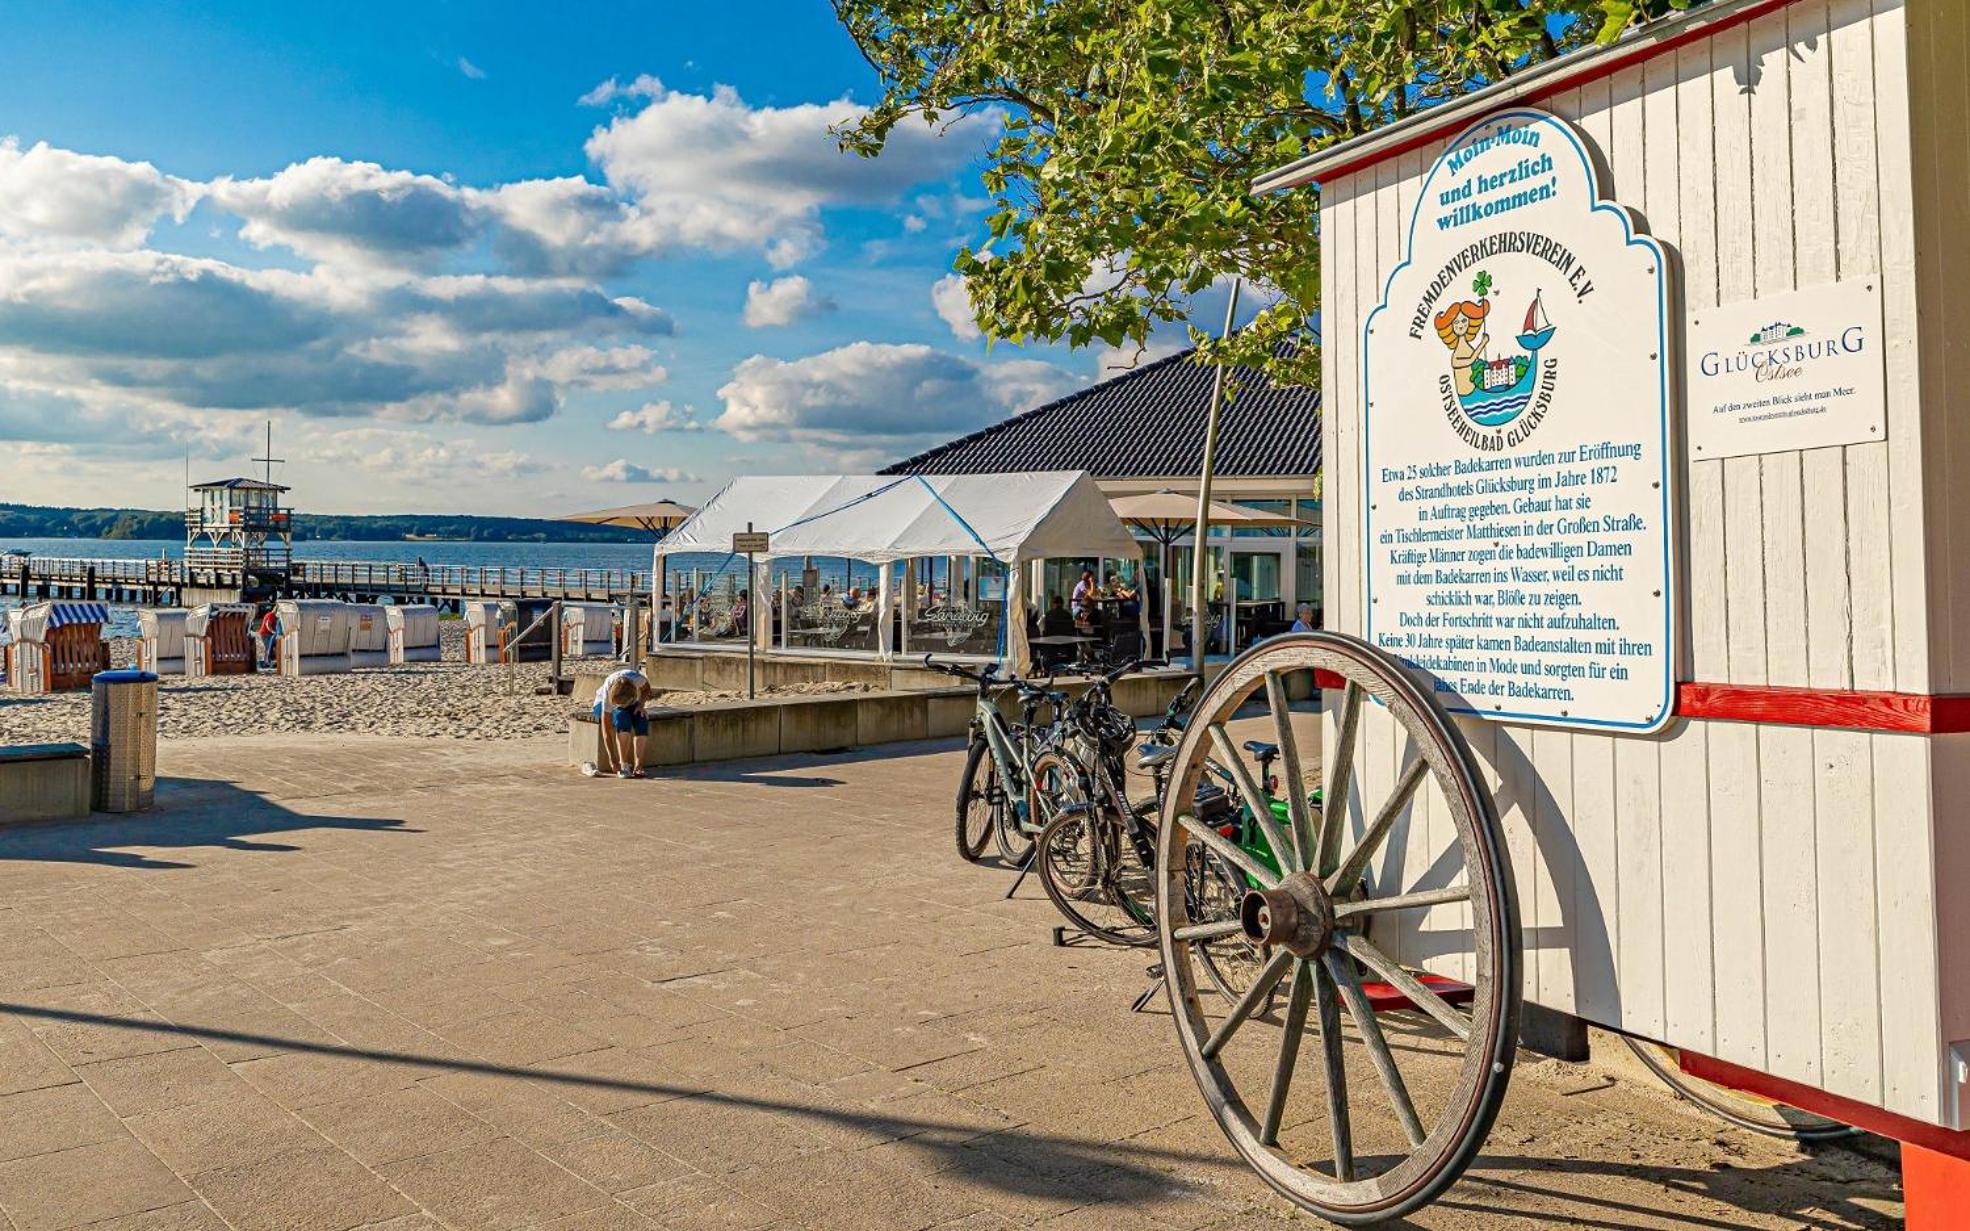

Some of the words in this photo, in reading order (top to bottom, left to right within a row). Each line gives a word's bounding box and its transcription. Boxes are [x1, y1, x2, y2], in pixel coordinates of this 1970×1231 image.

[1446, 124, 1541, 176] Moin-Moin
[1439, 178, 1472, 206] und
[1477, 153, 1553, 194] herzlich
[1436, 176, 1557, 230] willkommen!
[1409, 231, 1576, 340] FREMDENVERKEHRSVEREIN
[1568, 265, 1594, 304] E.V.
[1755, 360, 1803, 383] Ostsee
[1438, 373, 1504, 452] OSTSEEHEILBAD
[1507, 357, 1558, 448] GLÜCKSBURG
[1712, 404, 1727, 415] Auf
[1728, 400, 1741, 412] den
[1742, 397, 1771, 409] zweiten
[1772, 394, 1793, 405] Blick
[1794, 391, 1813, 403] sieht
[1814, 389, 1832, 400] man
[1382, 467, 1405, 483] Etwa
[1406, 464, 1418, 480] 25
[1419, 461, 1452, 479] solcher
[1454, 457, 1511, 475] Badekarren
[1514, 450, 1555, 468] wurden
[1558, 450, 1577, 463] zur
[1579, 441, 1641, 461] Eröffnung
[1398, 487, 1414, 502] des
[1415, 480, 1474, 500] Strandhotels
[1475, 475, 1535, 494] Glücksburg
[1538, 473, 1552, 489] im
[1555, 470, 1587, 488] Jahre
[1590, 465, 1618, 485] 1872
[1418, 506, 1428, 521] in
[1431, 503, 1467, 522] Auftrag
[1468, 500, 1511, 521] gegeben.
[1513, 496, 1552, 514] Gebaut
[1555, 495, 1573, 511] hat
[1575, 493, 1591, 509] sie
[1379, 530, 1393, 544] ein
[1395, 526, 1464, 544] Tischlermeister
[1466, 522, 1521, 540] Matthiesen
[1523, 520, 1534, 536] in
[1536, 519, 1554, 535] der
[1557, 516, 1600, 535] Großen
[1602, 513, 1647, 532] Straße.
[1390, 549, 1427, 567] Kräftige
[1429, 548, 1466, 563] Männer
[1467, 548, 1497, 565] zogen
[1498, 544, 1514, 560] die
[1516, 542, 1584, 562] badewilligen
[1587, 541, 1632, 557] Damen
[1396, 571, 1411, 585] mit
[1412, 570, 1433, 585] dem
[1435, 569, 1491, 584] Badekarren
[1493, 568, 1508, 583] ins
[1510, 566, 1550, 585] Wasser,
[1552, 565, 1575, 582] weil
[1577, 569, 1590, 581] es
[1592, 564, 1624, 581] nicht
[1426, 590, 1472, 606] schicklich
[1474, 594, 1496, 608] war,
[1497, 589, 1526, 606] Blöße
[1528, 593, 1541, 606] zu
[1543, 589, 1582, 610] zeigen.
[1399, 612, 1423, 627] Doch
[1424, 612, 1440, 627] der
[1442, 612, 1493, 628] Fortschritt
[1495, 615, 1515, 629] war
[1517, 612, 1544, 629] nicht
[1546, 612, 1620, 631] aufzuhalten.
[1378, 633, 1403, 648] Keine
[1404, 633, 1416, 648] 30
[1417, 633, 1443, 649] Jahre
[1444, 635, 1475, 653] später
[1476, 635, 1511, 651] kamen
[1513, 635, 1592, 654] Badeanstalten
[1594, 638, 1616, 655] mit
[1618, 638, 1653, 656] ihren
[1476, 657, 1487, 672] in
[1489, 658, 1518, 674] Mode
[1520, 659, 1542, 675] und
[1544, 663, 1585, 681] sorgten
[1588, 661, 1607, 679] für
[1609, 663, 1628, 680] ein
[1459, 678, 1486, 695] Ende
[1487, 679, 1505, 696] der
[1507, 681, 1574, 701] Badekarren.
